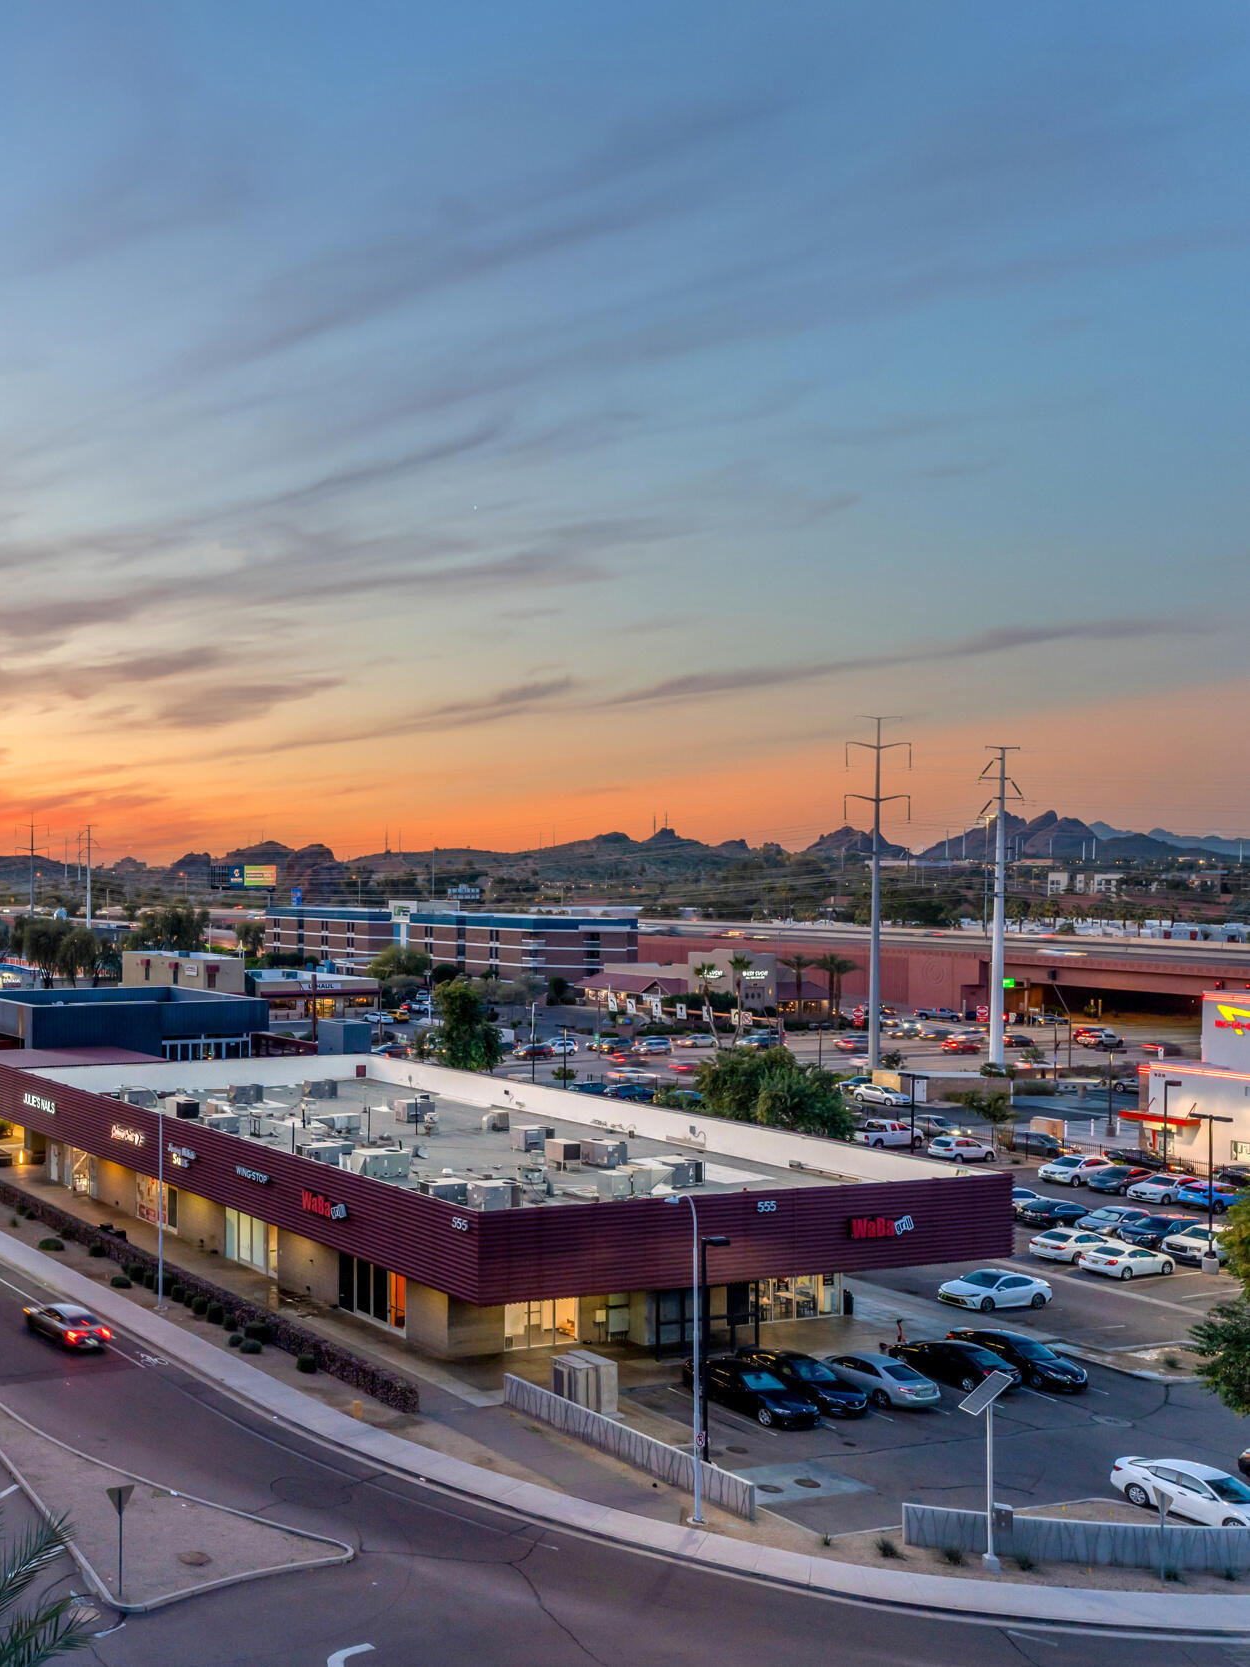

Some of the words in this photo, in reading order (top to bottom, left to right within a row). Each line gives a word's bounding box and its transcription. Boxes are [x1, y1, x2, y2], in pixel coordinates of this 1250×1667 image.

[41, 1098, 55, 1114] NAILS
[302, 1189, 331, 1218] WaBa
[757, 1201, 777, 1213] 555
[451, 1216, 469, 1232] 555
[851, 1217, 895, 1239] WaBa
[895, 1215, 914, 1235] grill
